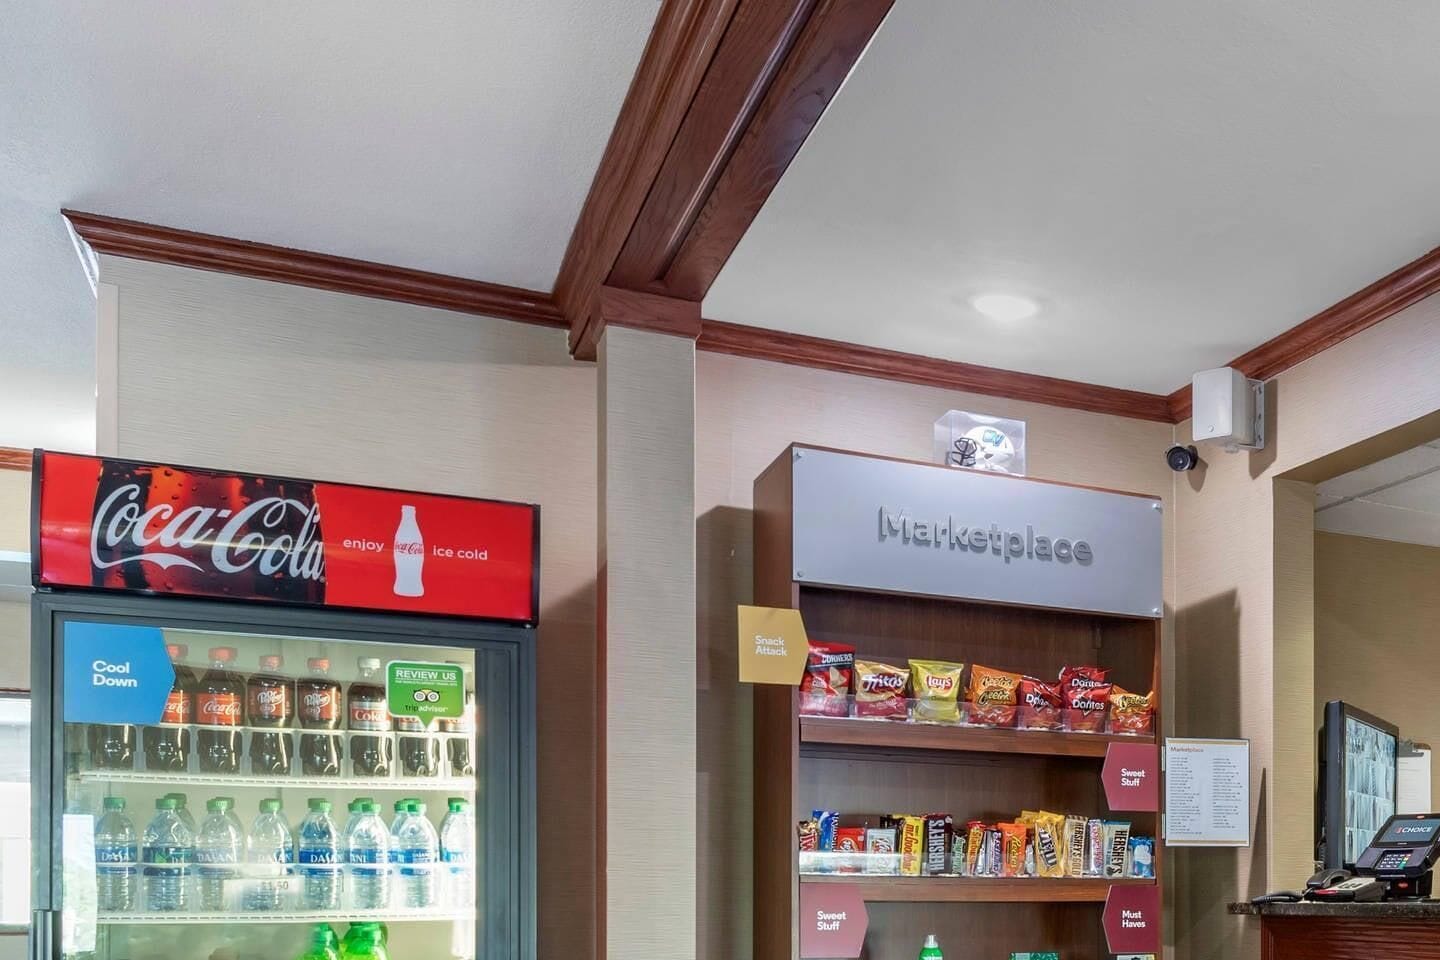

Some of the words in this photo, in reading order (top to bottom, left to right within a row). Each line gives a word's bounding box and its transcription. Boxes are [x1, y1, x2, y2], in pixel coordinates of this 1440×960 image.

[90, 483, 326, 582] Coca-Cola
[878, 506, 1093, 564] Marketplace
[343, 538, 384, 552] enjoy
[433, 545, 453, 558] ice
[457, 549, 488, 560] cold
[755, 635, 785, 646] Snack
[755, 645, 788, 657] Attack
[92, 660, 130, 674] Cool
[92, 673, 138, 688] Down
[396, 669, 438, 679] REVIEW
[442, 672, 457, 681] US
[862, 673, 904, 691] Fritos
[405, 704, 449, 713] tripadvisor
[1072, 698, 1105, 710] Doritos
[1121, 768, 1146, 778] Sweet
[1121, 778, 1140, 787] Stuff
[929, 819, 945, 871] HERSHEY'S
[310, 853, 343, 863] DASAN
[1111, 830, 1128, 874] HERSHEY'S
[817, 911, 847, 920] Sweet
[1122, 910, 1142, 919] Must
[817, 921, 840, 931] Stuff
[1122, 919, 1146, 928] Haves
